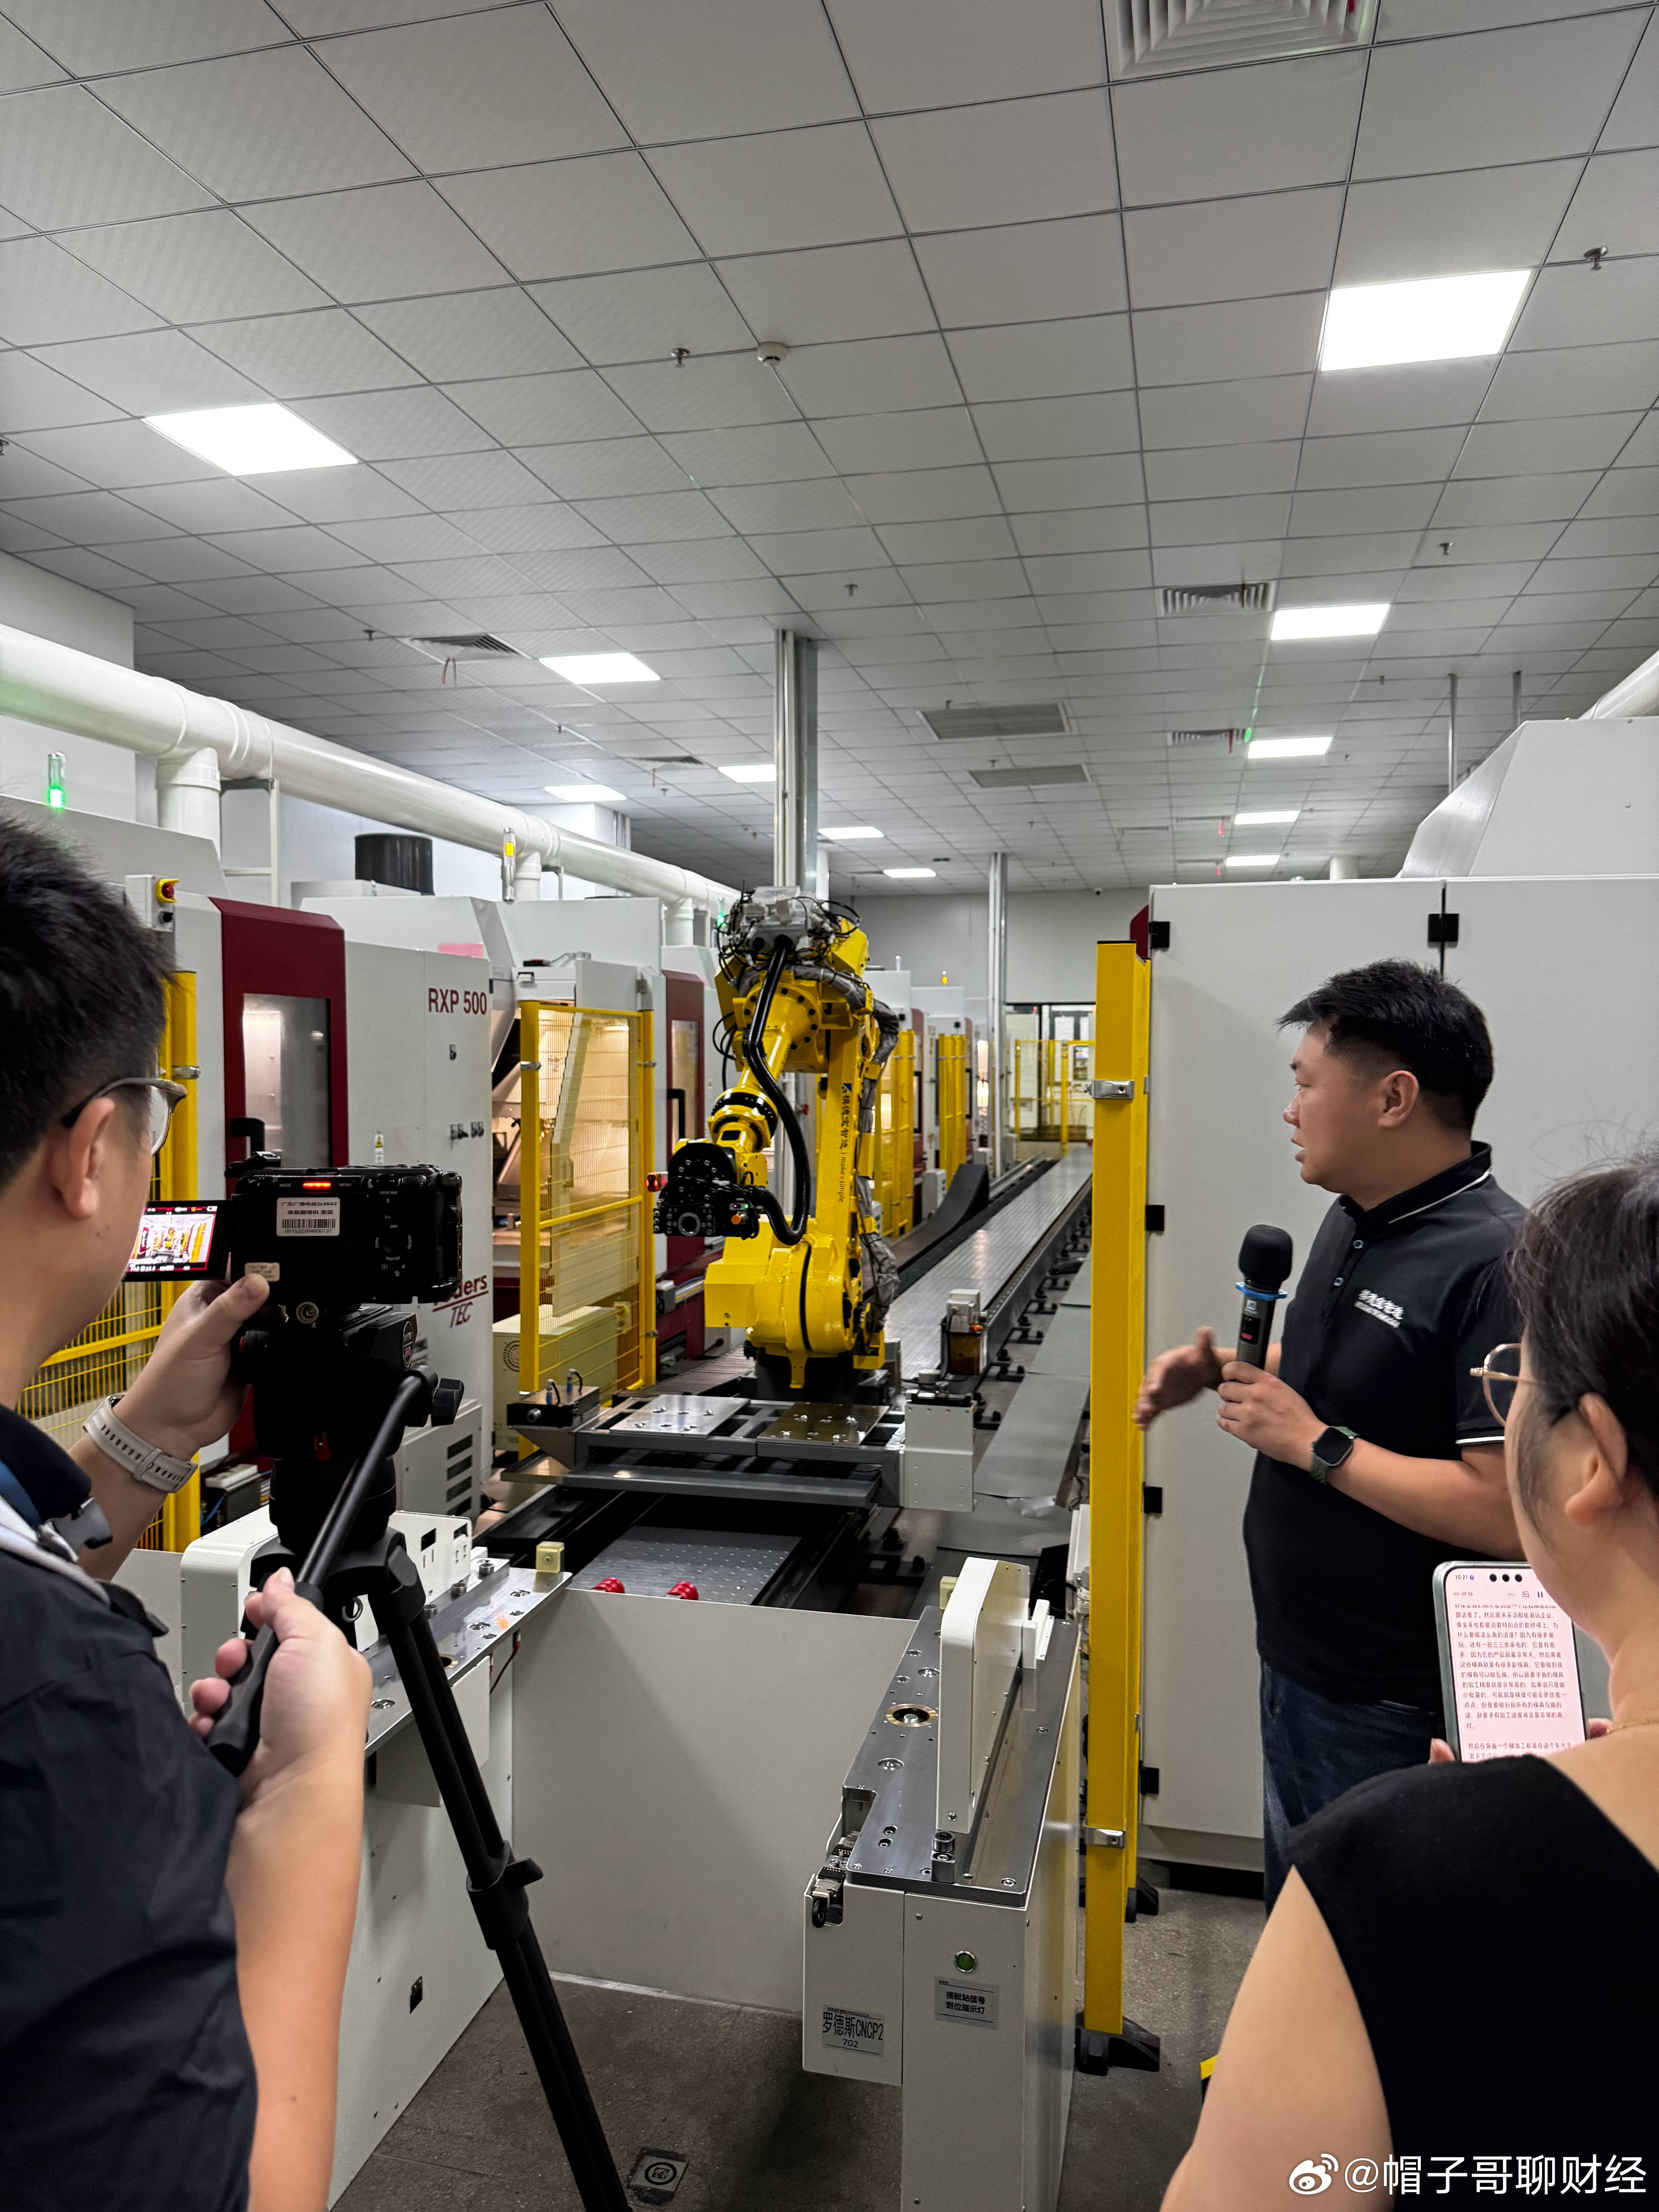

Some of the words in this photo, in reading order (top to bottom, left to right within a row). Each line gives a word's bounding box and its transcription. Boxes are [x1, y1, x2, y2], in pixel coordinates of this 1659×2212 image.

[429, 988, 459, 1013] RXP
[464, 991, 487, 1015] 500
[838, 1180, 846, 1202] simple
[453, 1275, 487, 1299] ders
[449, 1301, 473, 1328] TEC
[946, 1991, 986, 2004] 接驳站信号
[946, 2001, 986, 2014] 到位指示灯
[823, 2011, 883, 2041] 罗德斯CNCP2
[843, 2039, 859, 2048] 702
